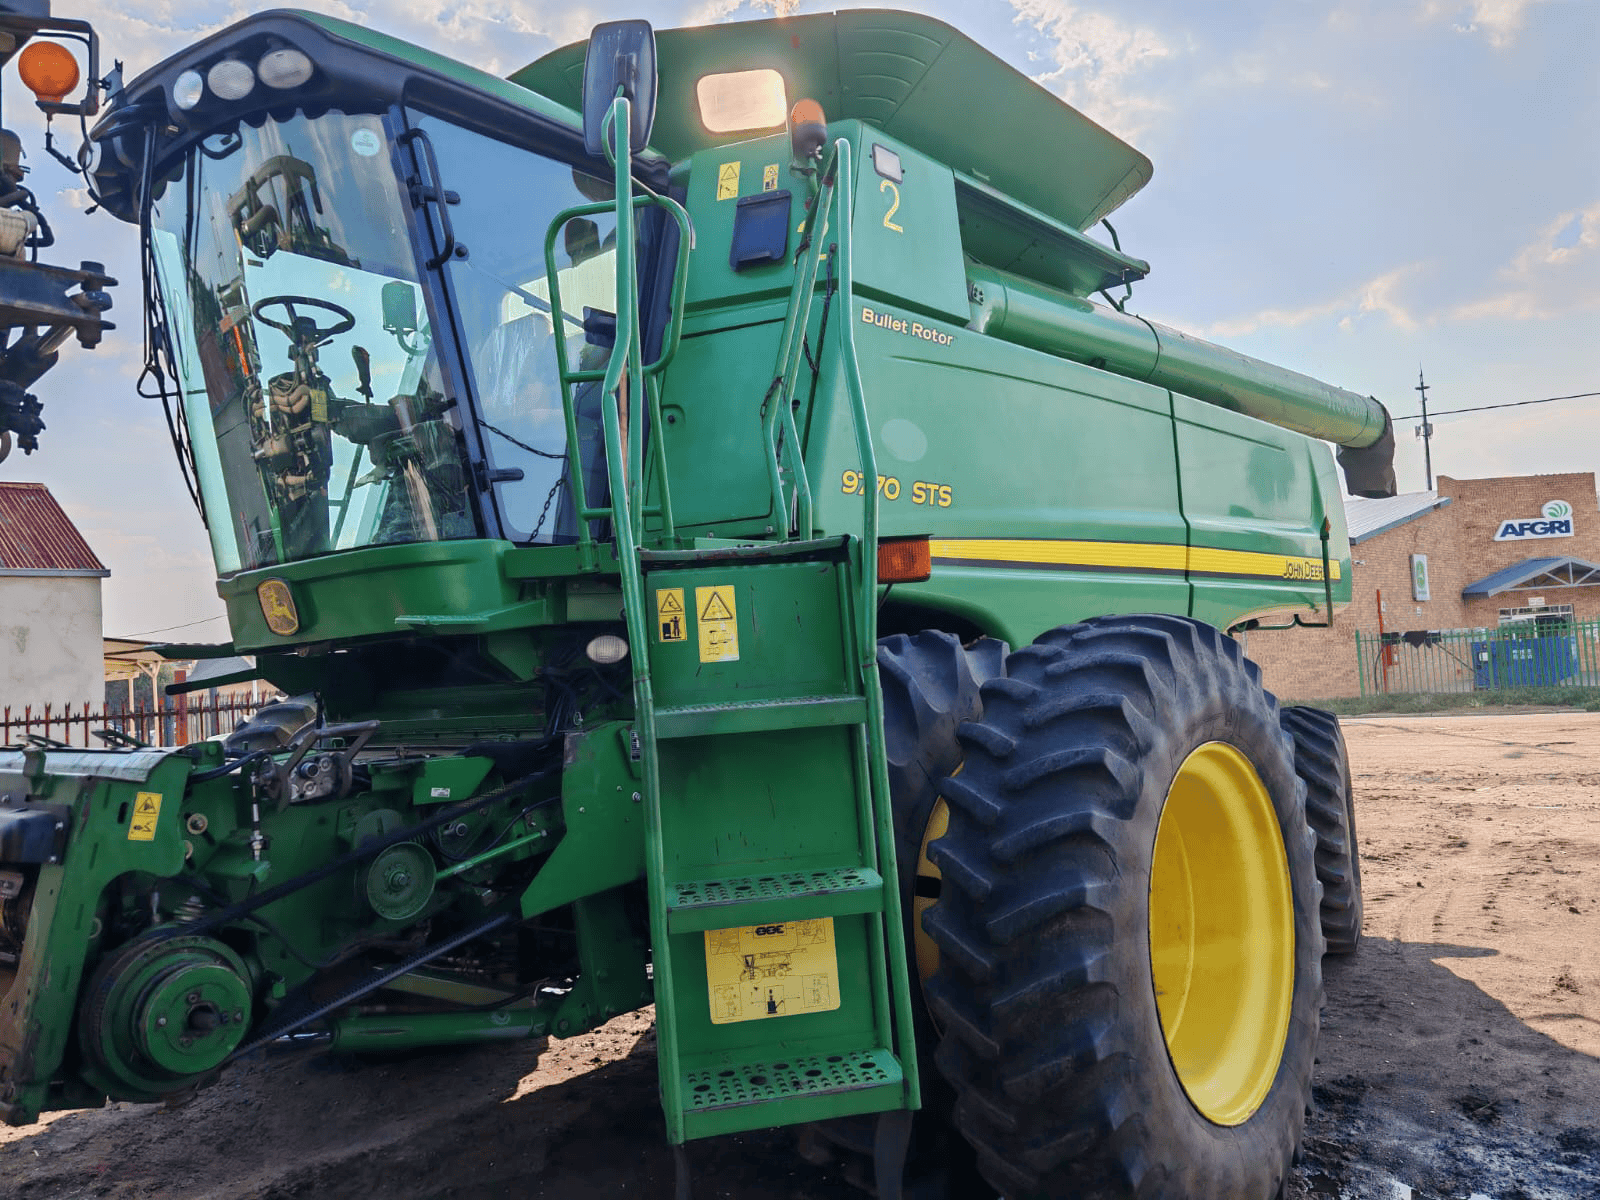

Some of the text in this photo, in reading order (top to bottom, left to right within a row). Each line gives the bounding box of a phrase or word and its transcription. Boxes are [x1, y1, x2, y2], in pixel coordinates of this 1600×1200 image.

[879, 179, 904, 234] 2
[861, 306, 954, 347] Bullet Rotor
[912, 480, 952, 508] STS
[1499, 519, 1571, 537] AFGRI
[1283, 559, 1326, 580] JOHN DEER
